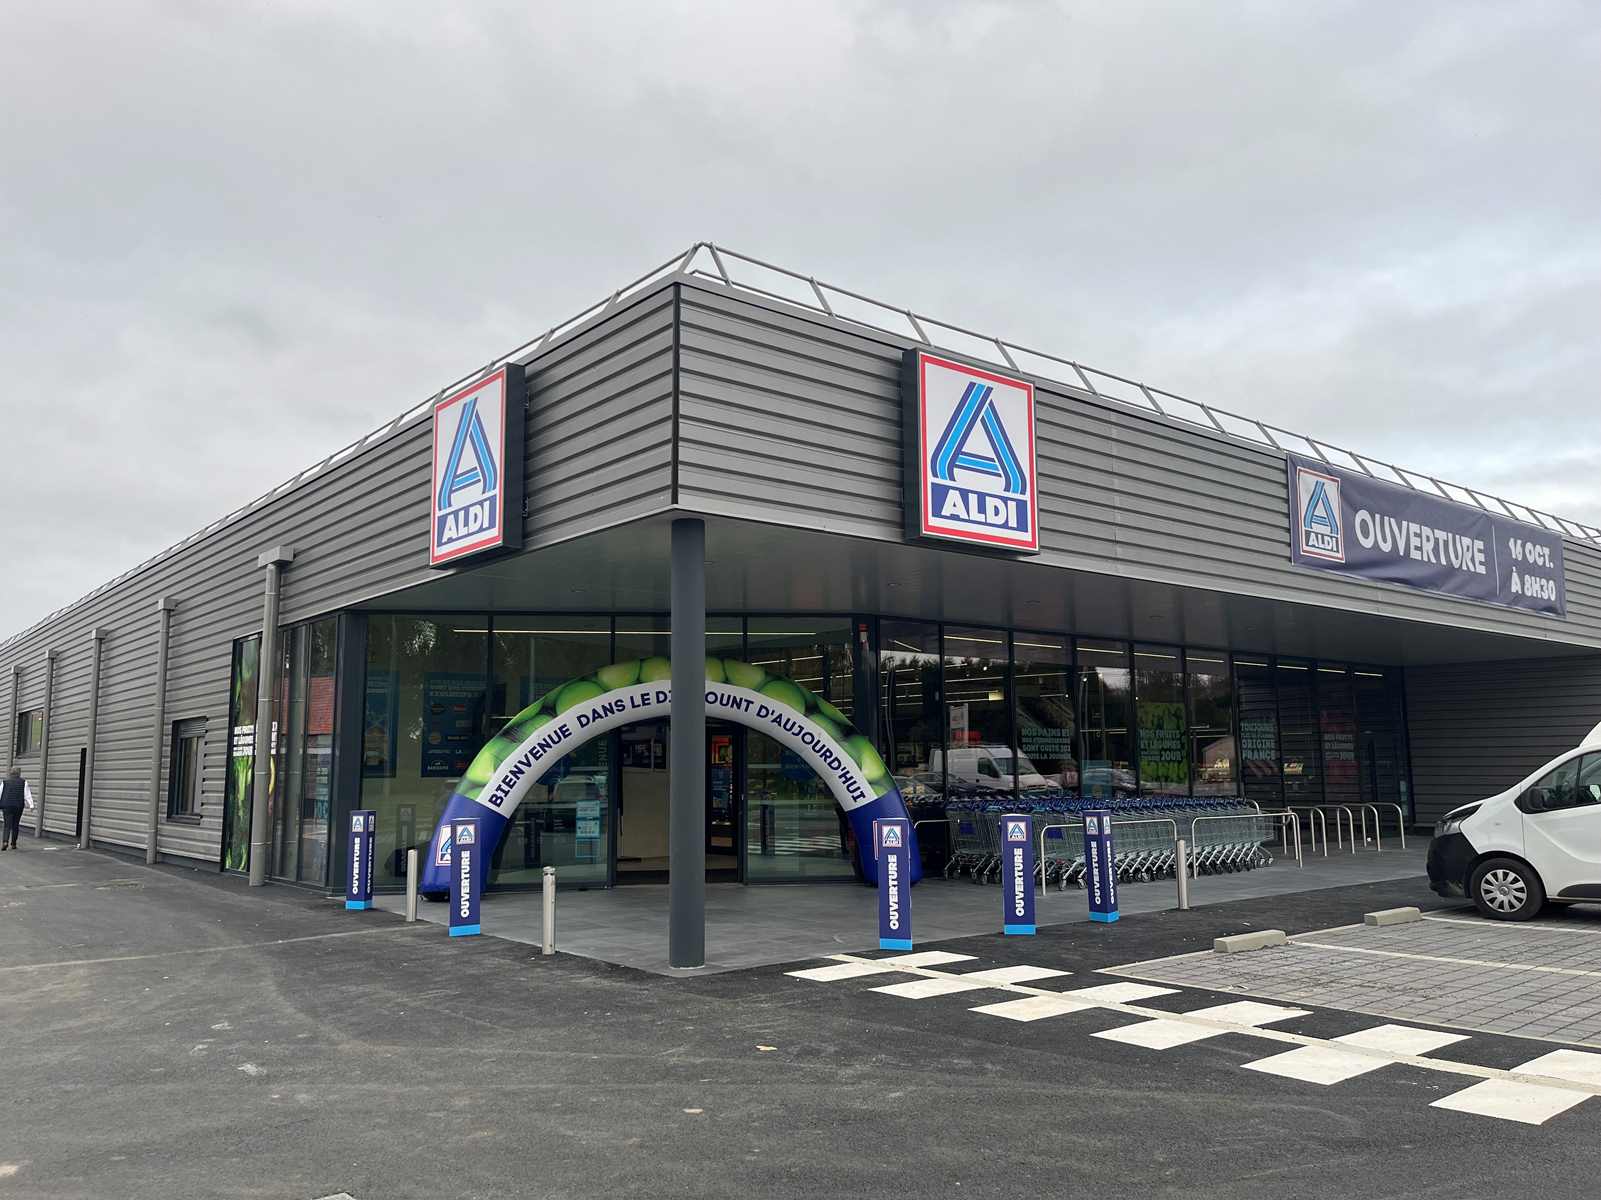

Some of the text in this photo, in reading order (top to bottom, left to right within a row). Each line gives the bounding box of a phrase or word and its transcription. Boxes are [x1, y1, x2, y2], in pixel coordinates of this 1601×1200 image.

[441, 500, 490, 543] ALDI
[941, 489, 1018, 528] ALDI
[1308, 532, 1337, 552] ALDI
[1354, 509, 1487, 575] OUVERTURE
[1508, 537, 1554, 568] 16 OCT.
[1511, 567, 1556, 601] À 8H30
[488, 690, 867, 808] BIENVENUE DANS LE DOUNT D'AUJOURD'HUI
[352, 837, 360, 895] OUVERTURE
[460, 850, 470, 918] OUVERTURE
[887, 854, 899, 930] OUVERTURE
[1013, 847, 1025, 917] OUVERTURE
[1090, 841, 1101, 905] OUVERTURE
[1106, 840, 1115, 904] OUVERTURE
